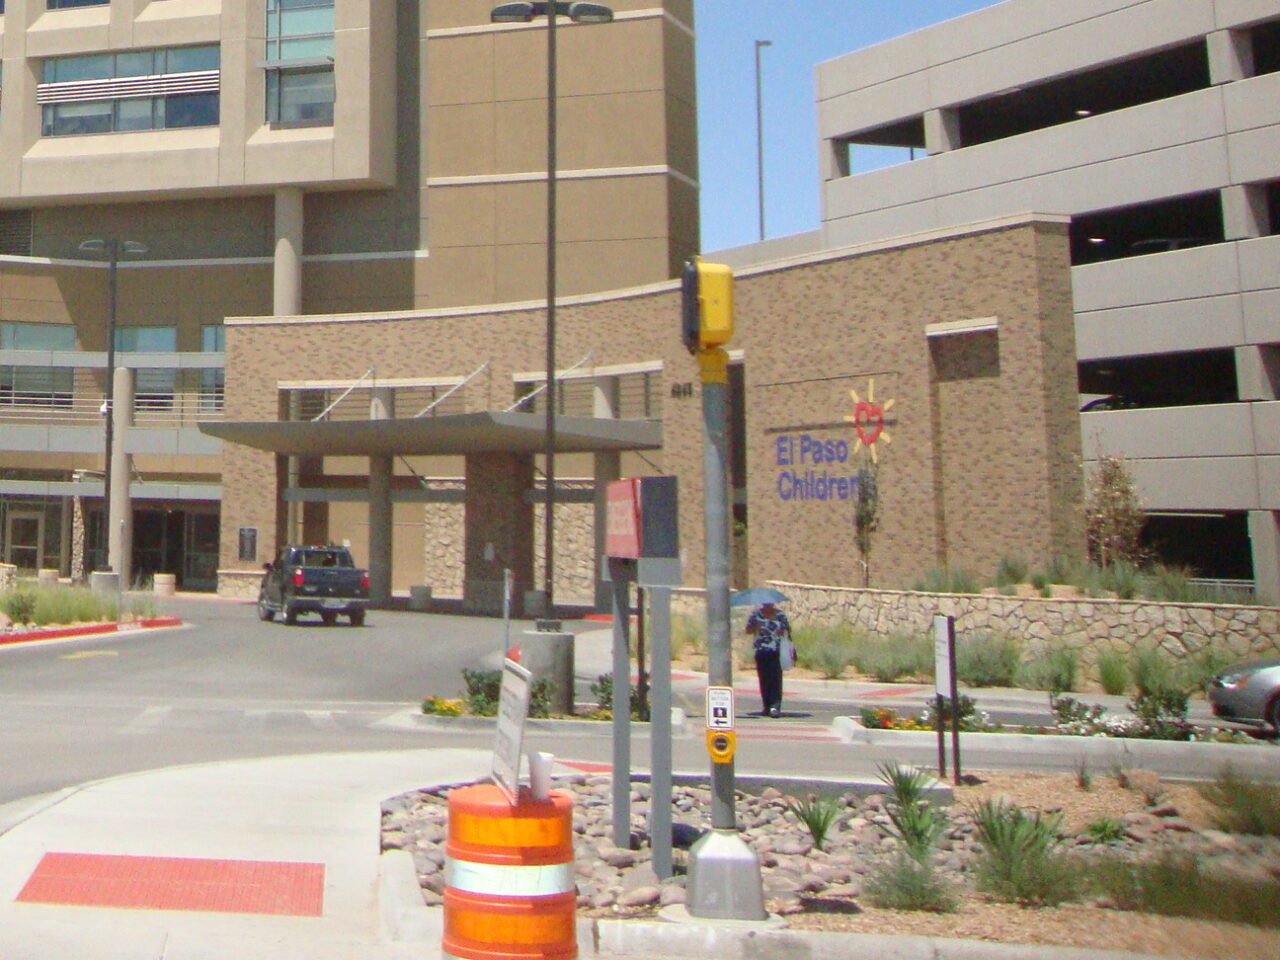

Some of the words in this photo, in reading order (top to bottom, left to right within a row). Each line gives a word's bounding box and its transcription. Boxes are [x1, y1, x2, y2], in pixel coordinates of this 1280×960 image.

[776, 435, 794, 466] El
[800, 434, 848, 464] Paso
[778, 470, 876, 500] Children
